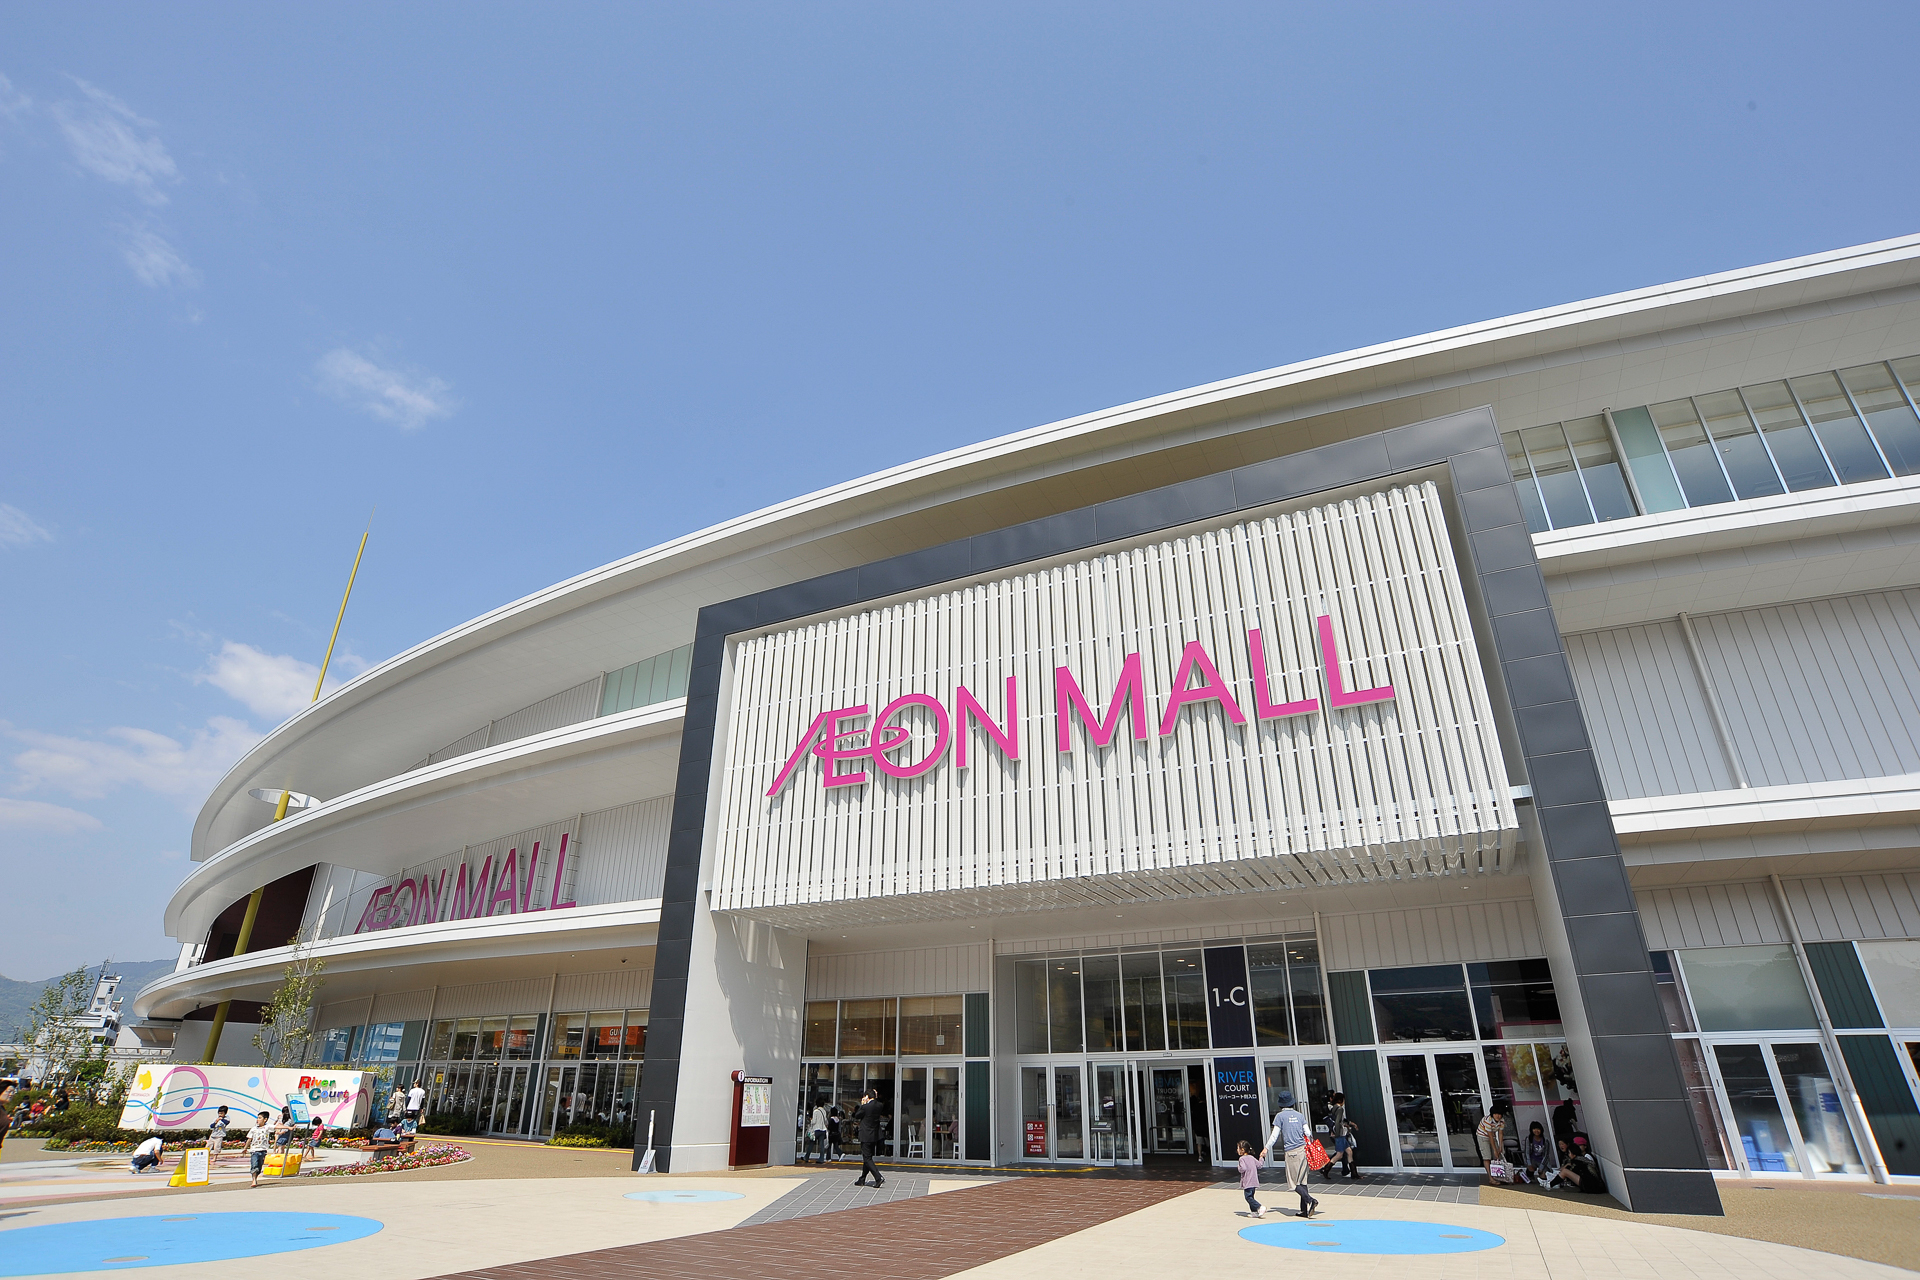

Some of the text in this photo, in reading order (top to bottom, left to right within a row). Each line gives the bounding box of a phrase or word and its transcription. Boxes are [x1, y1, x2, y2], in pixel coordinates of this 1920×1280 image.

[1056, 615, 1395, 751] MALL
[450, 833, 577, 921] MALL
[1212, 986, 1246, 1007] 1-C
[298, 1076, 336, 1088] River
[1217, 1071, 1255, 1083] RIVER
[309, 1088, 349, 1100] Court
[1224, 1084, 1250, 1092] COURT
[1229, 1103, 1250, 1116] 1-C
